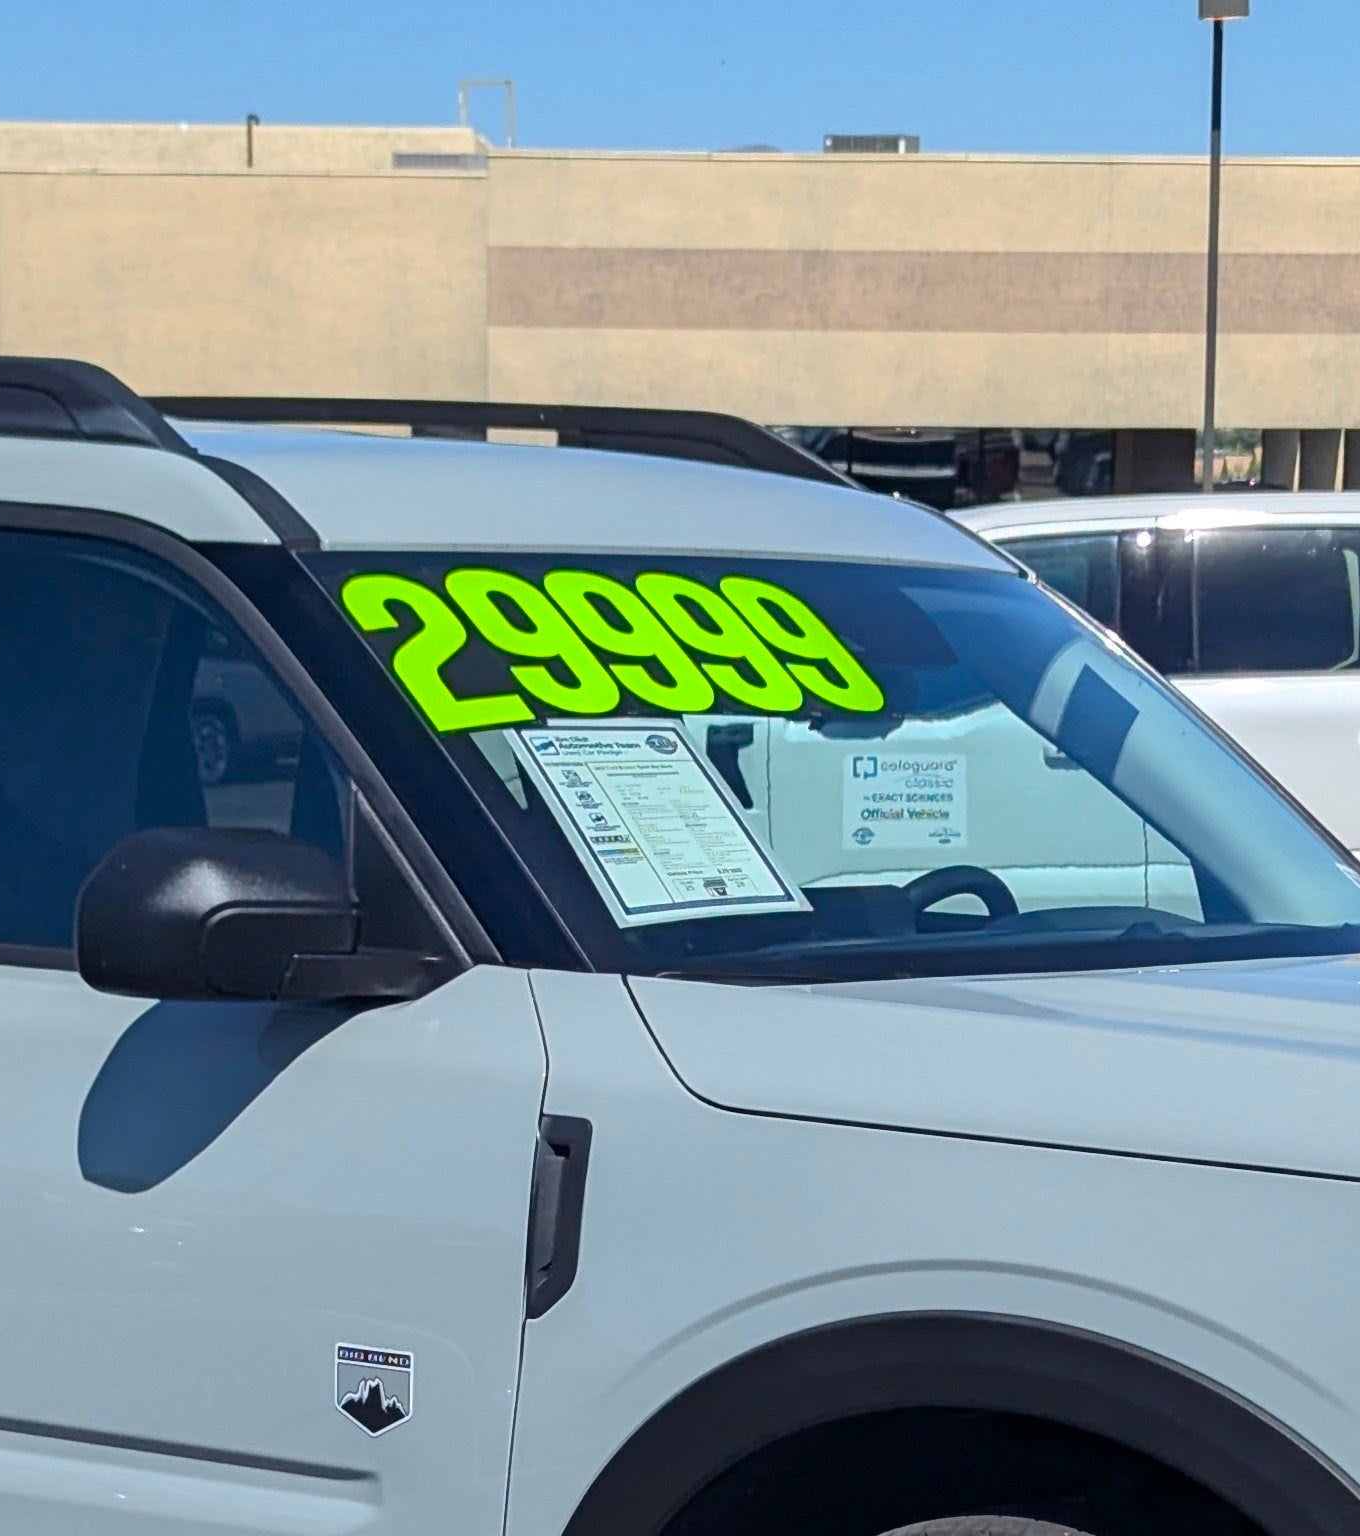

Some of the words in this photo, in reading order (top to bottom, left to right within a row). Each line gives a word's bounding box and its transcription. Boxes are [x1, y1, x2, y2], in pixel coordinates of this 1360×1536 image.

[341, 568, 885, 733] 29999
[871, 793, 903, 803] EXACT
[860, 808, 904, 820] Official
[907, 808, 950, 820] Vehicle
[367, 1353, 410, 1366] BEND
